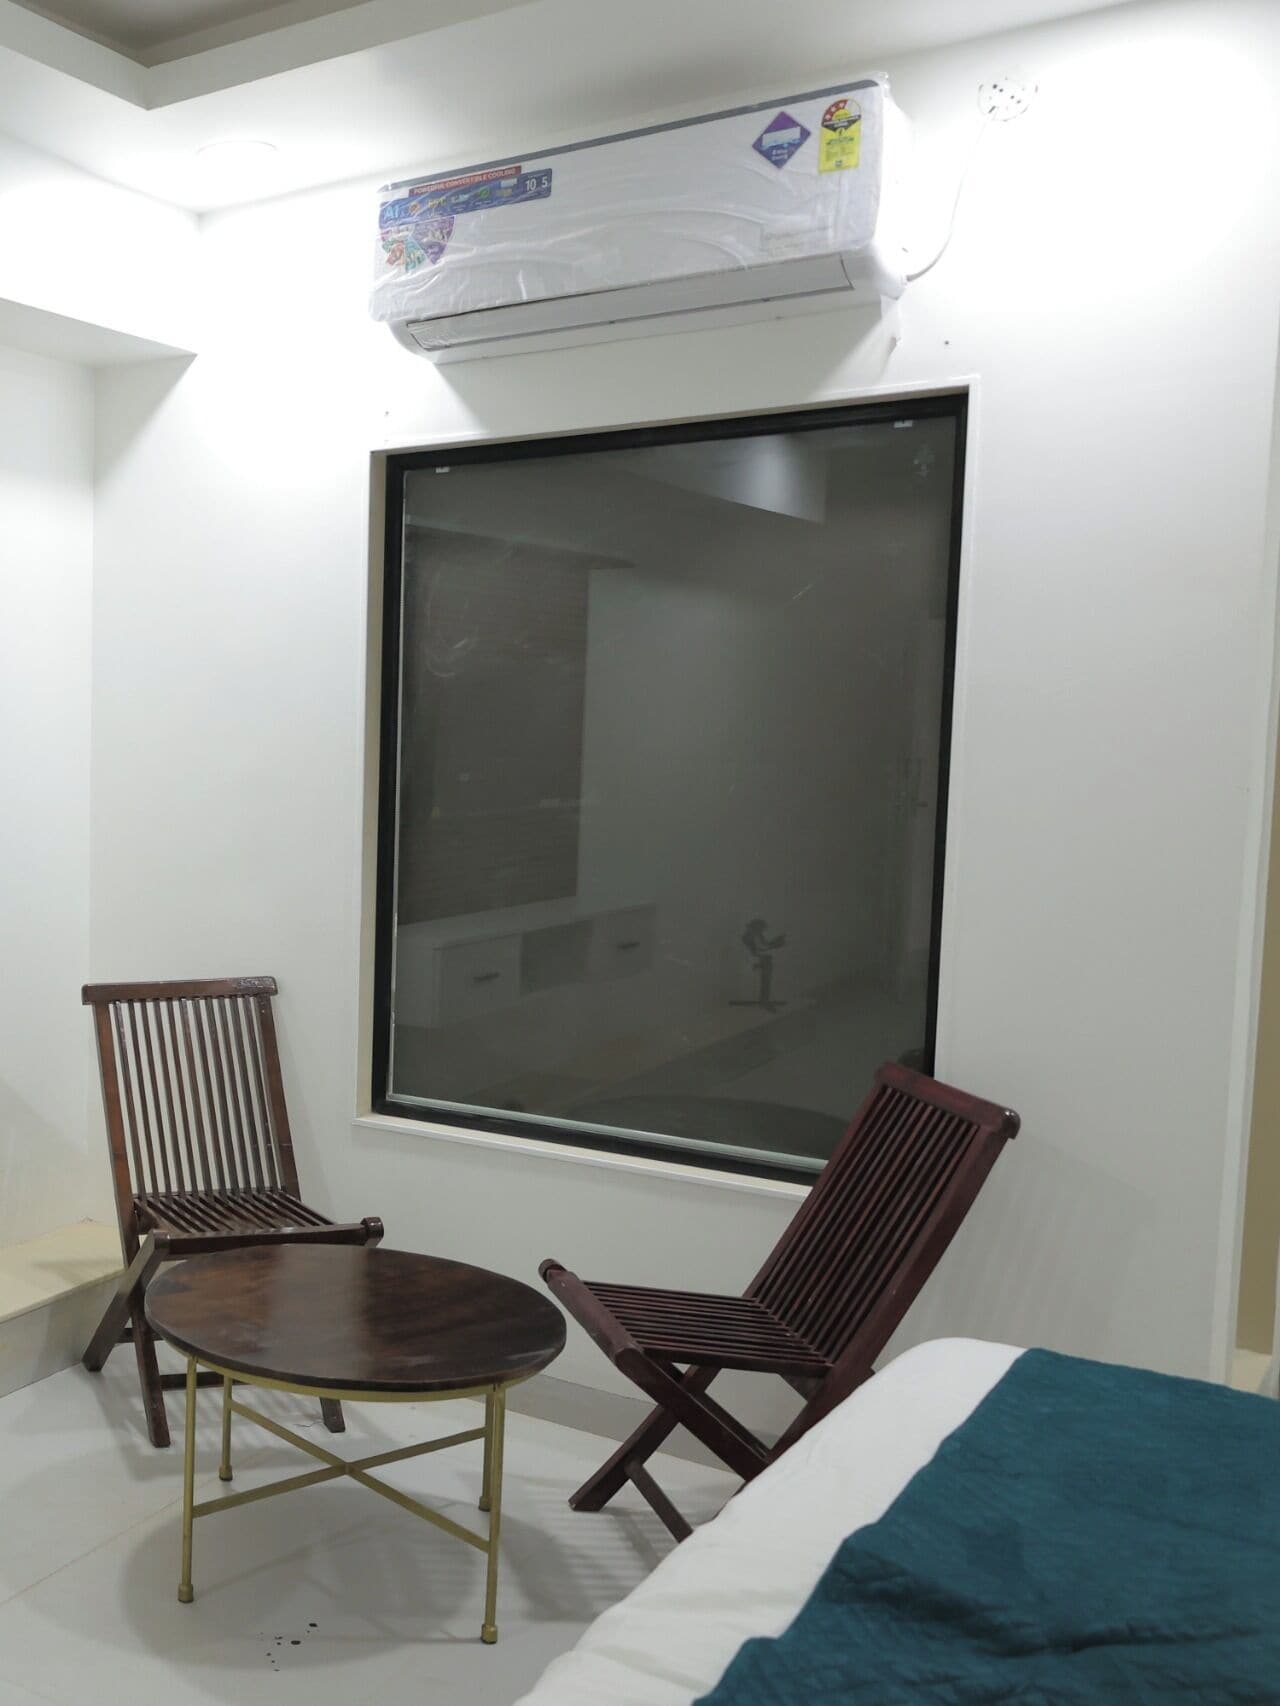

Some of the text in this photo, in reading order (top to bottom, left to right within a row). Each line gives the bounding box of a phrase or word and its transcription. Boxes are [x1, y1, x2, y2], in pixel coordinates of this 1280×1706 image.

[488, 168, 516, 179] COOLING
[525, 175, 548, 191] 10 5
